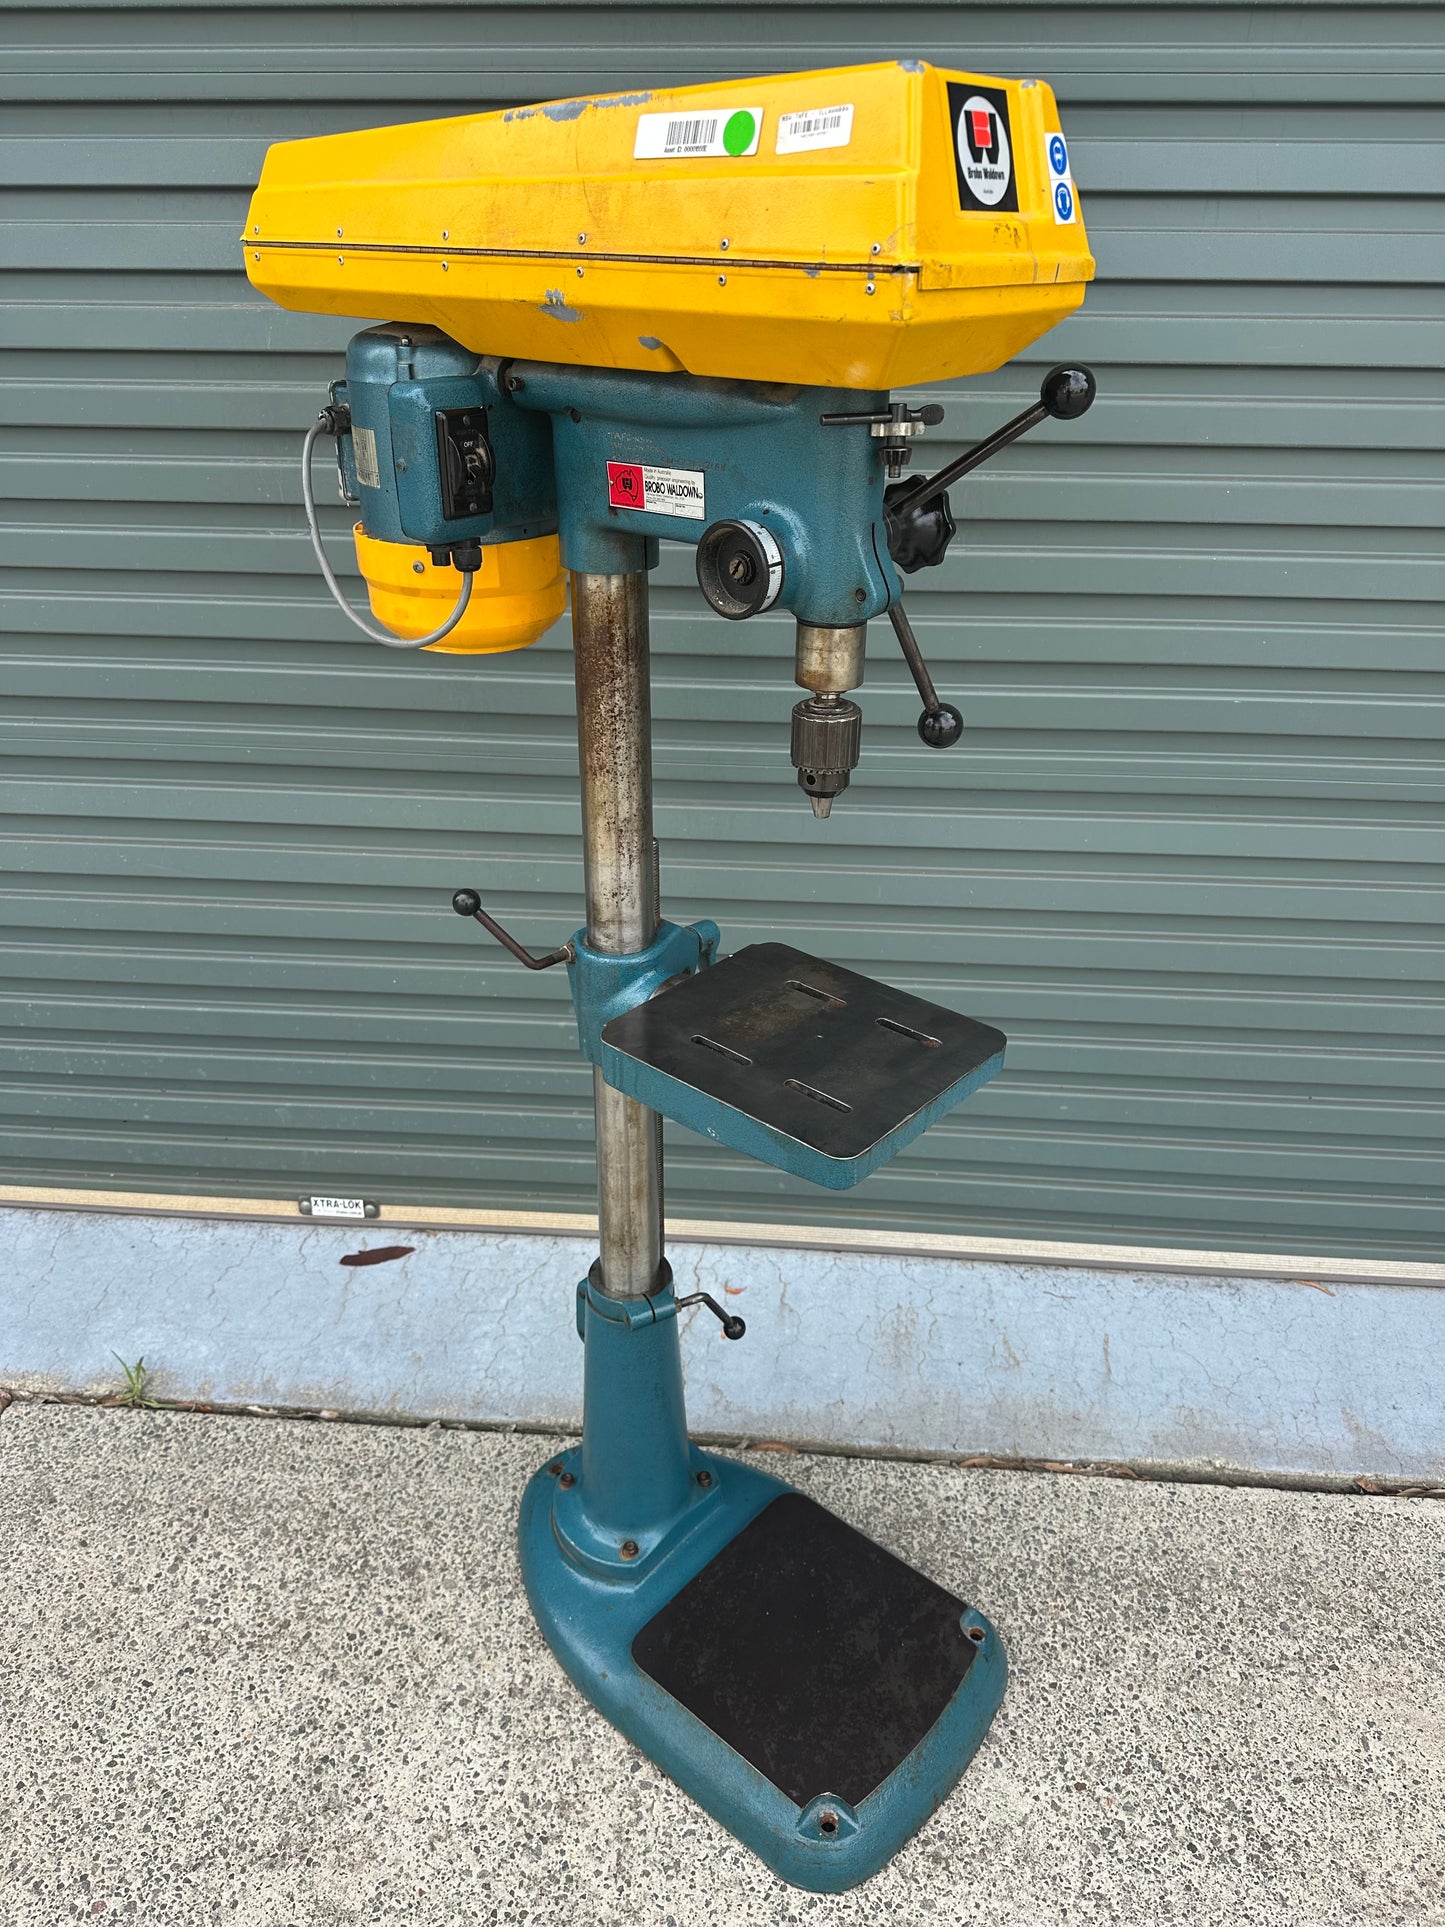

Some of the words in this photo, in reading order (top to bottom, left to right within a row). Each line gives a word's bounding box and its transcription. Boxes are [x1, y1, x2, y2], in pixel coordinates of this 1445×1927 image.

[983, 167, 1005, 180] Waldown
[645, 480, 666, 494] BROBO
[666, 483, 699, 498] WALDOWN
[313, 1199, 362, 1210] XTRA-LOK
